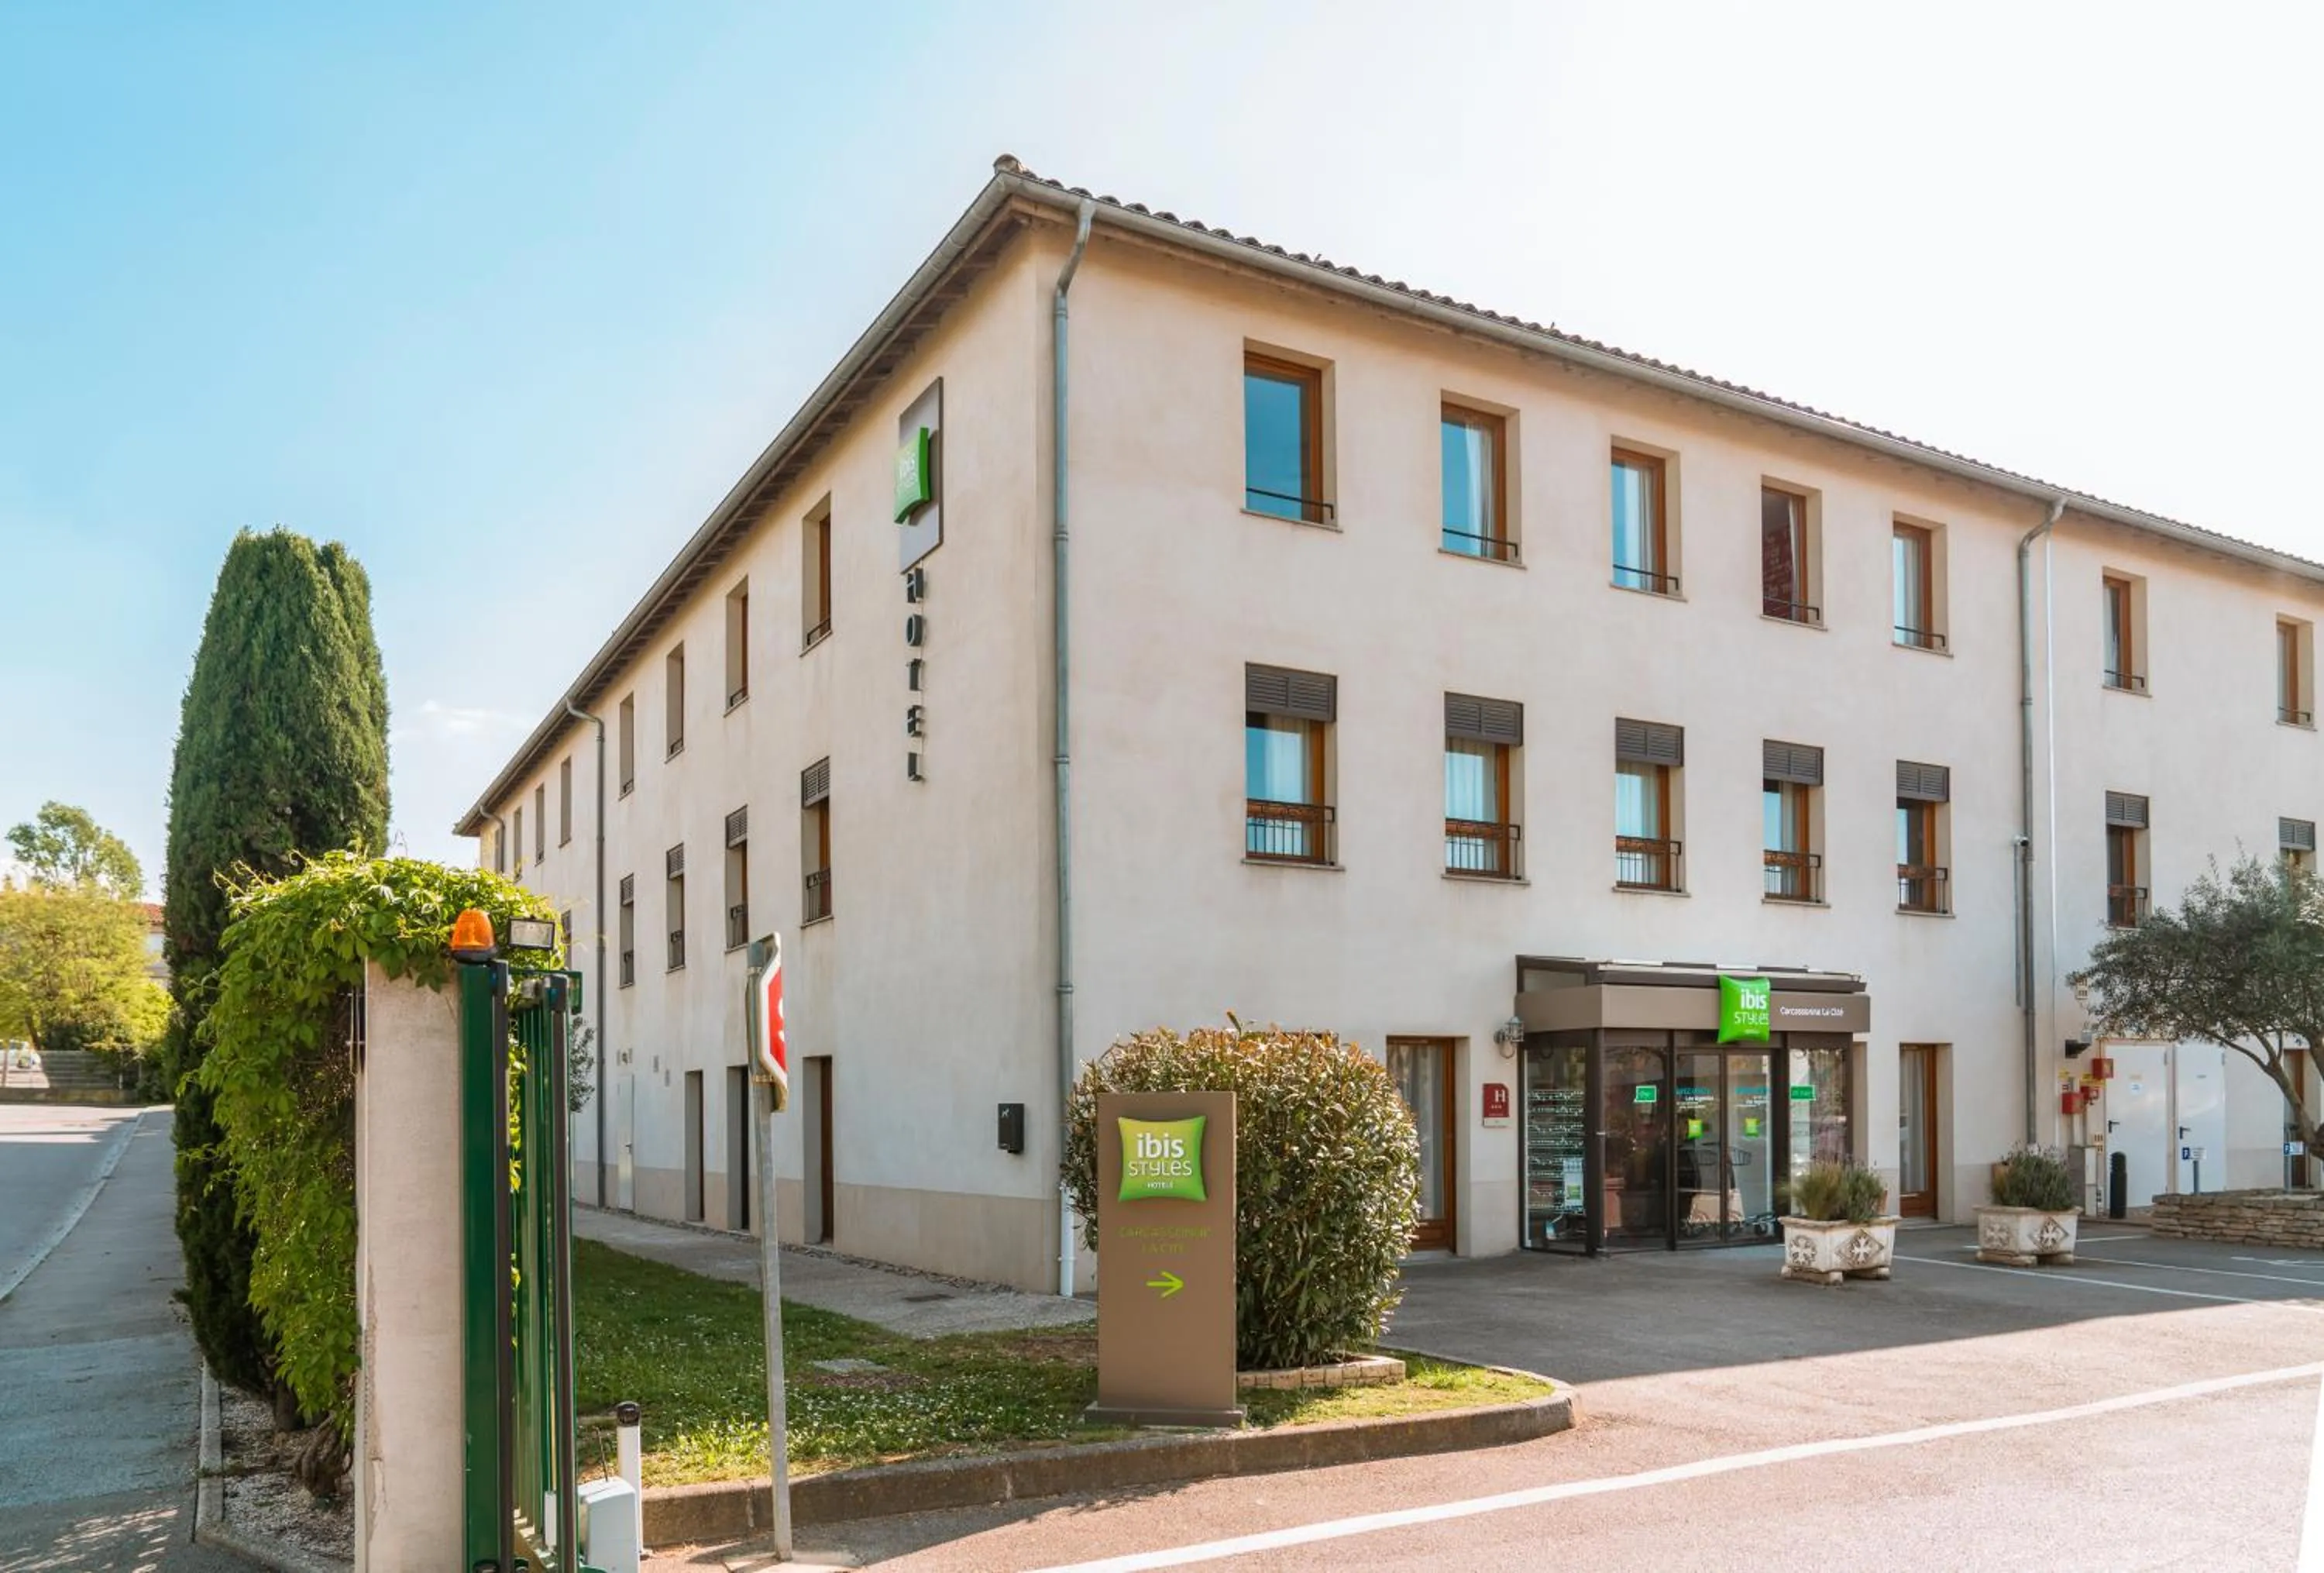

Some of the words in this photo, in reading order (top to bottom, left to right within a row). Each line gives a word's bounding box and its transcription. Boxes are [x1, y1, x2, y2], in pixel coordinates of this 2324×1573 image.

[1740, 988, 1767, 1010] ibis
[1779, 1007, 1820, 1016] Carcassonne
[1494, 1089, 1506, 1103] H
[1136, 1132, 1184, 1158] ibis
